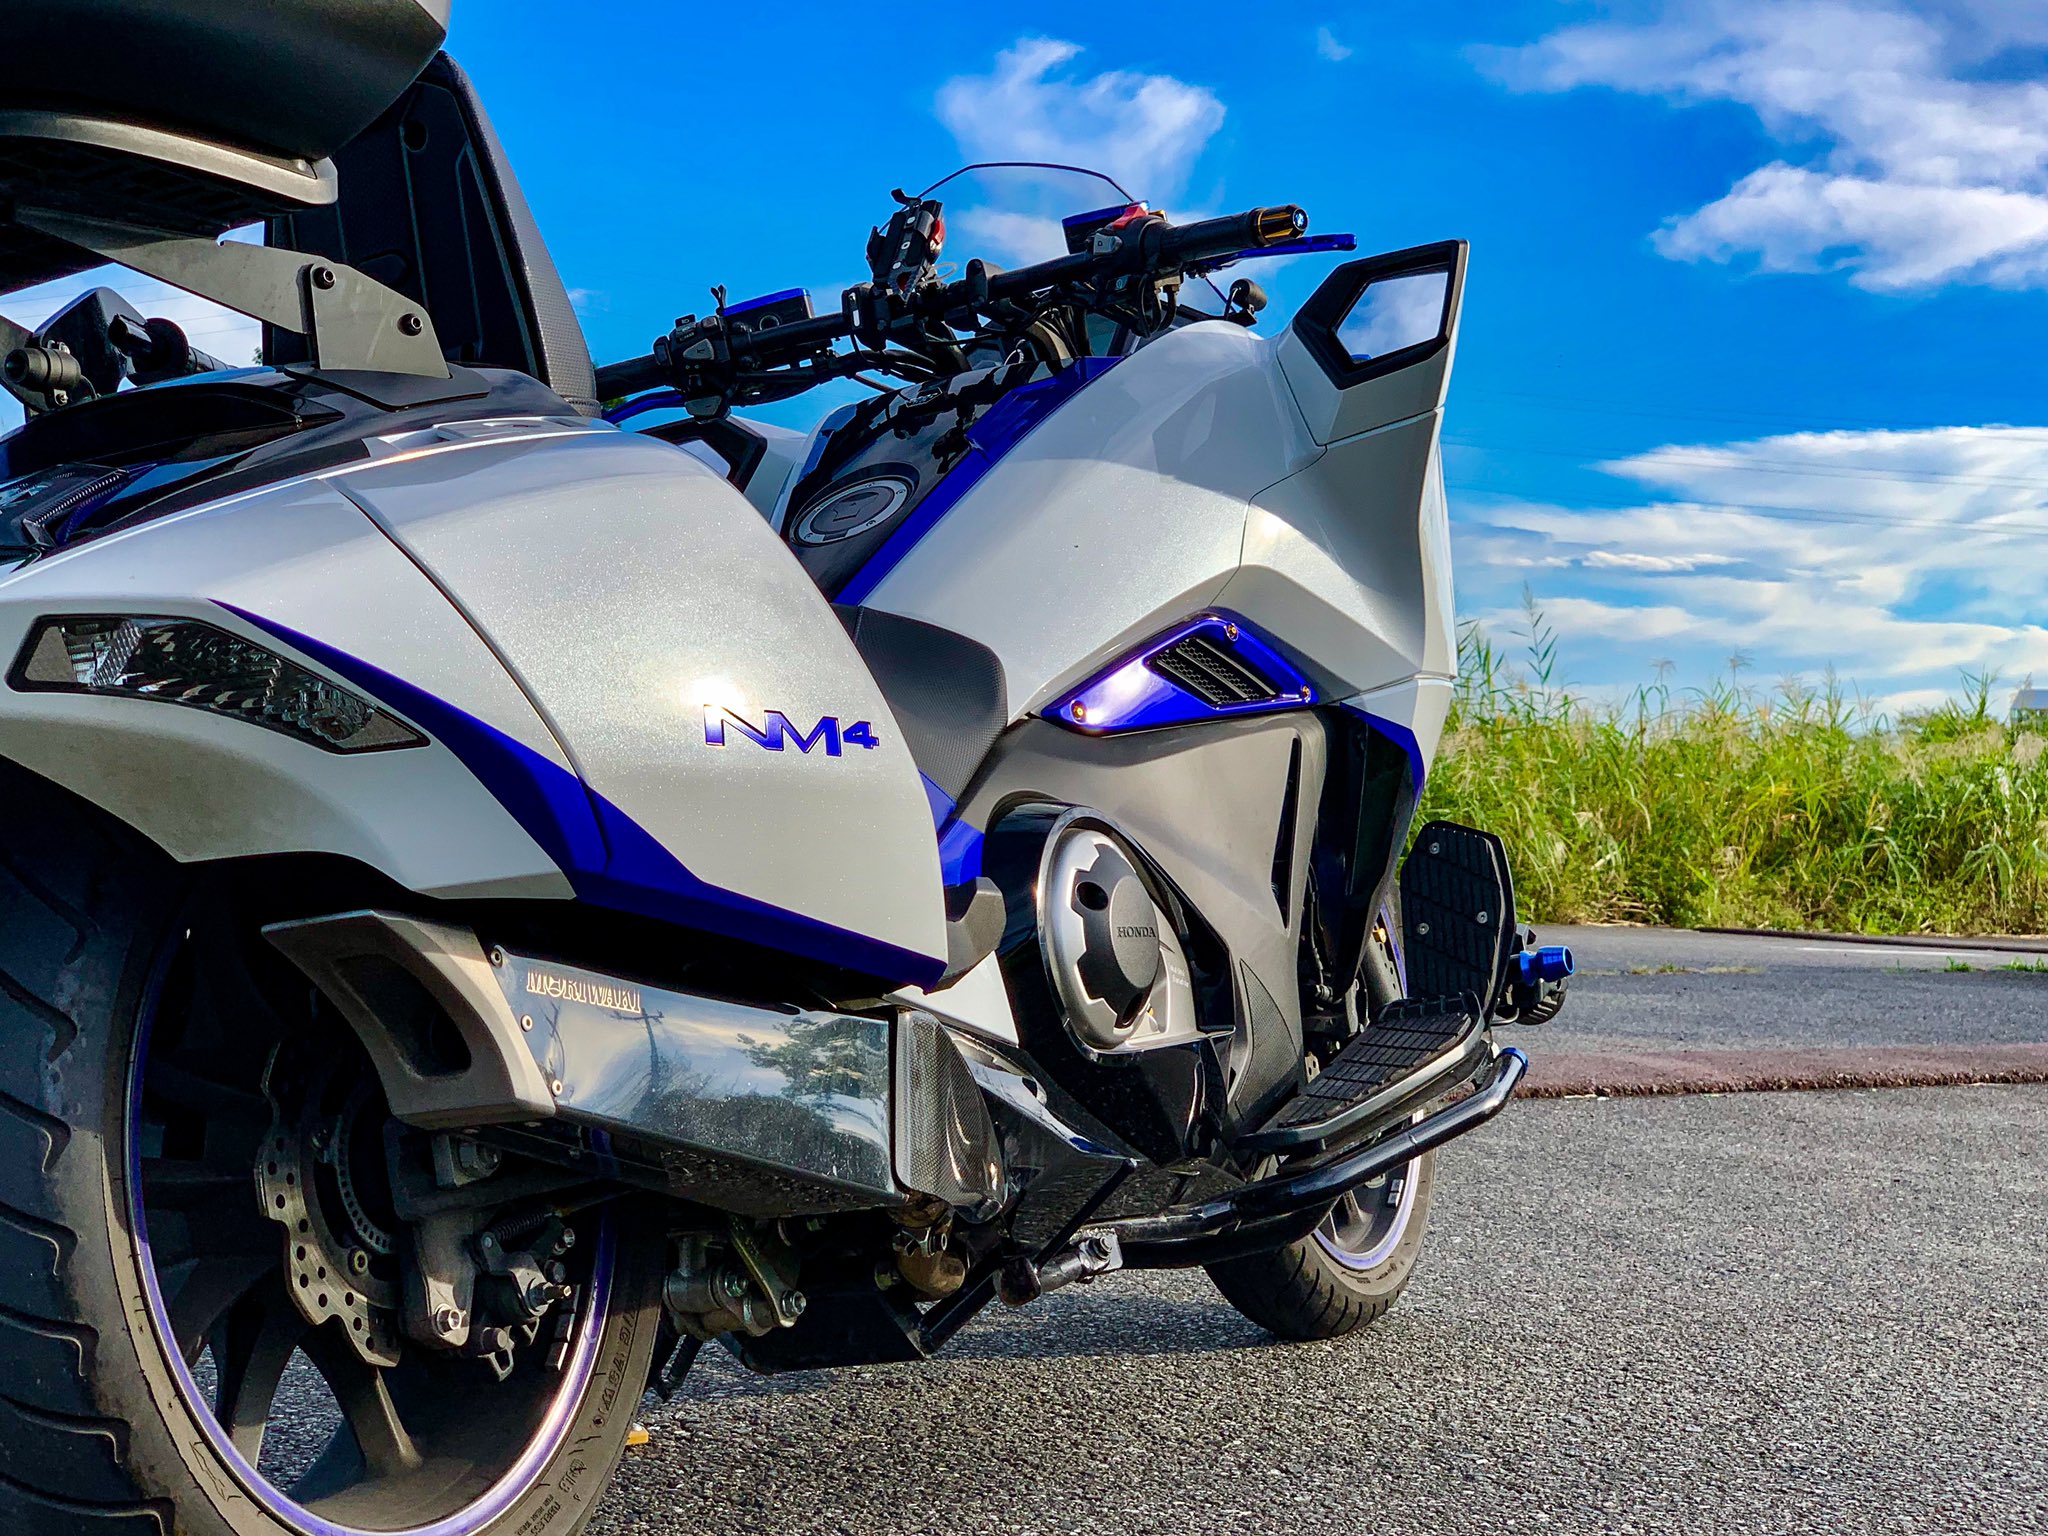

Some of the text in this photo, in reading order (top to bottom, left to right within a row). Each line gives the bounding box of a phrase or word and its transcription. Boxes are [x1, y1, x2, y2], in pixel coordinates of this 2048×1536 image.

[703, 704, 879, 757] NM4
[1116, 926, 1157, 938] HONDA
[526, 969, 641, 1013] MORIWAKI
